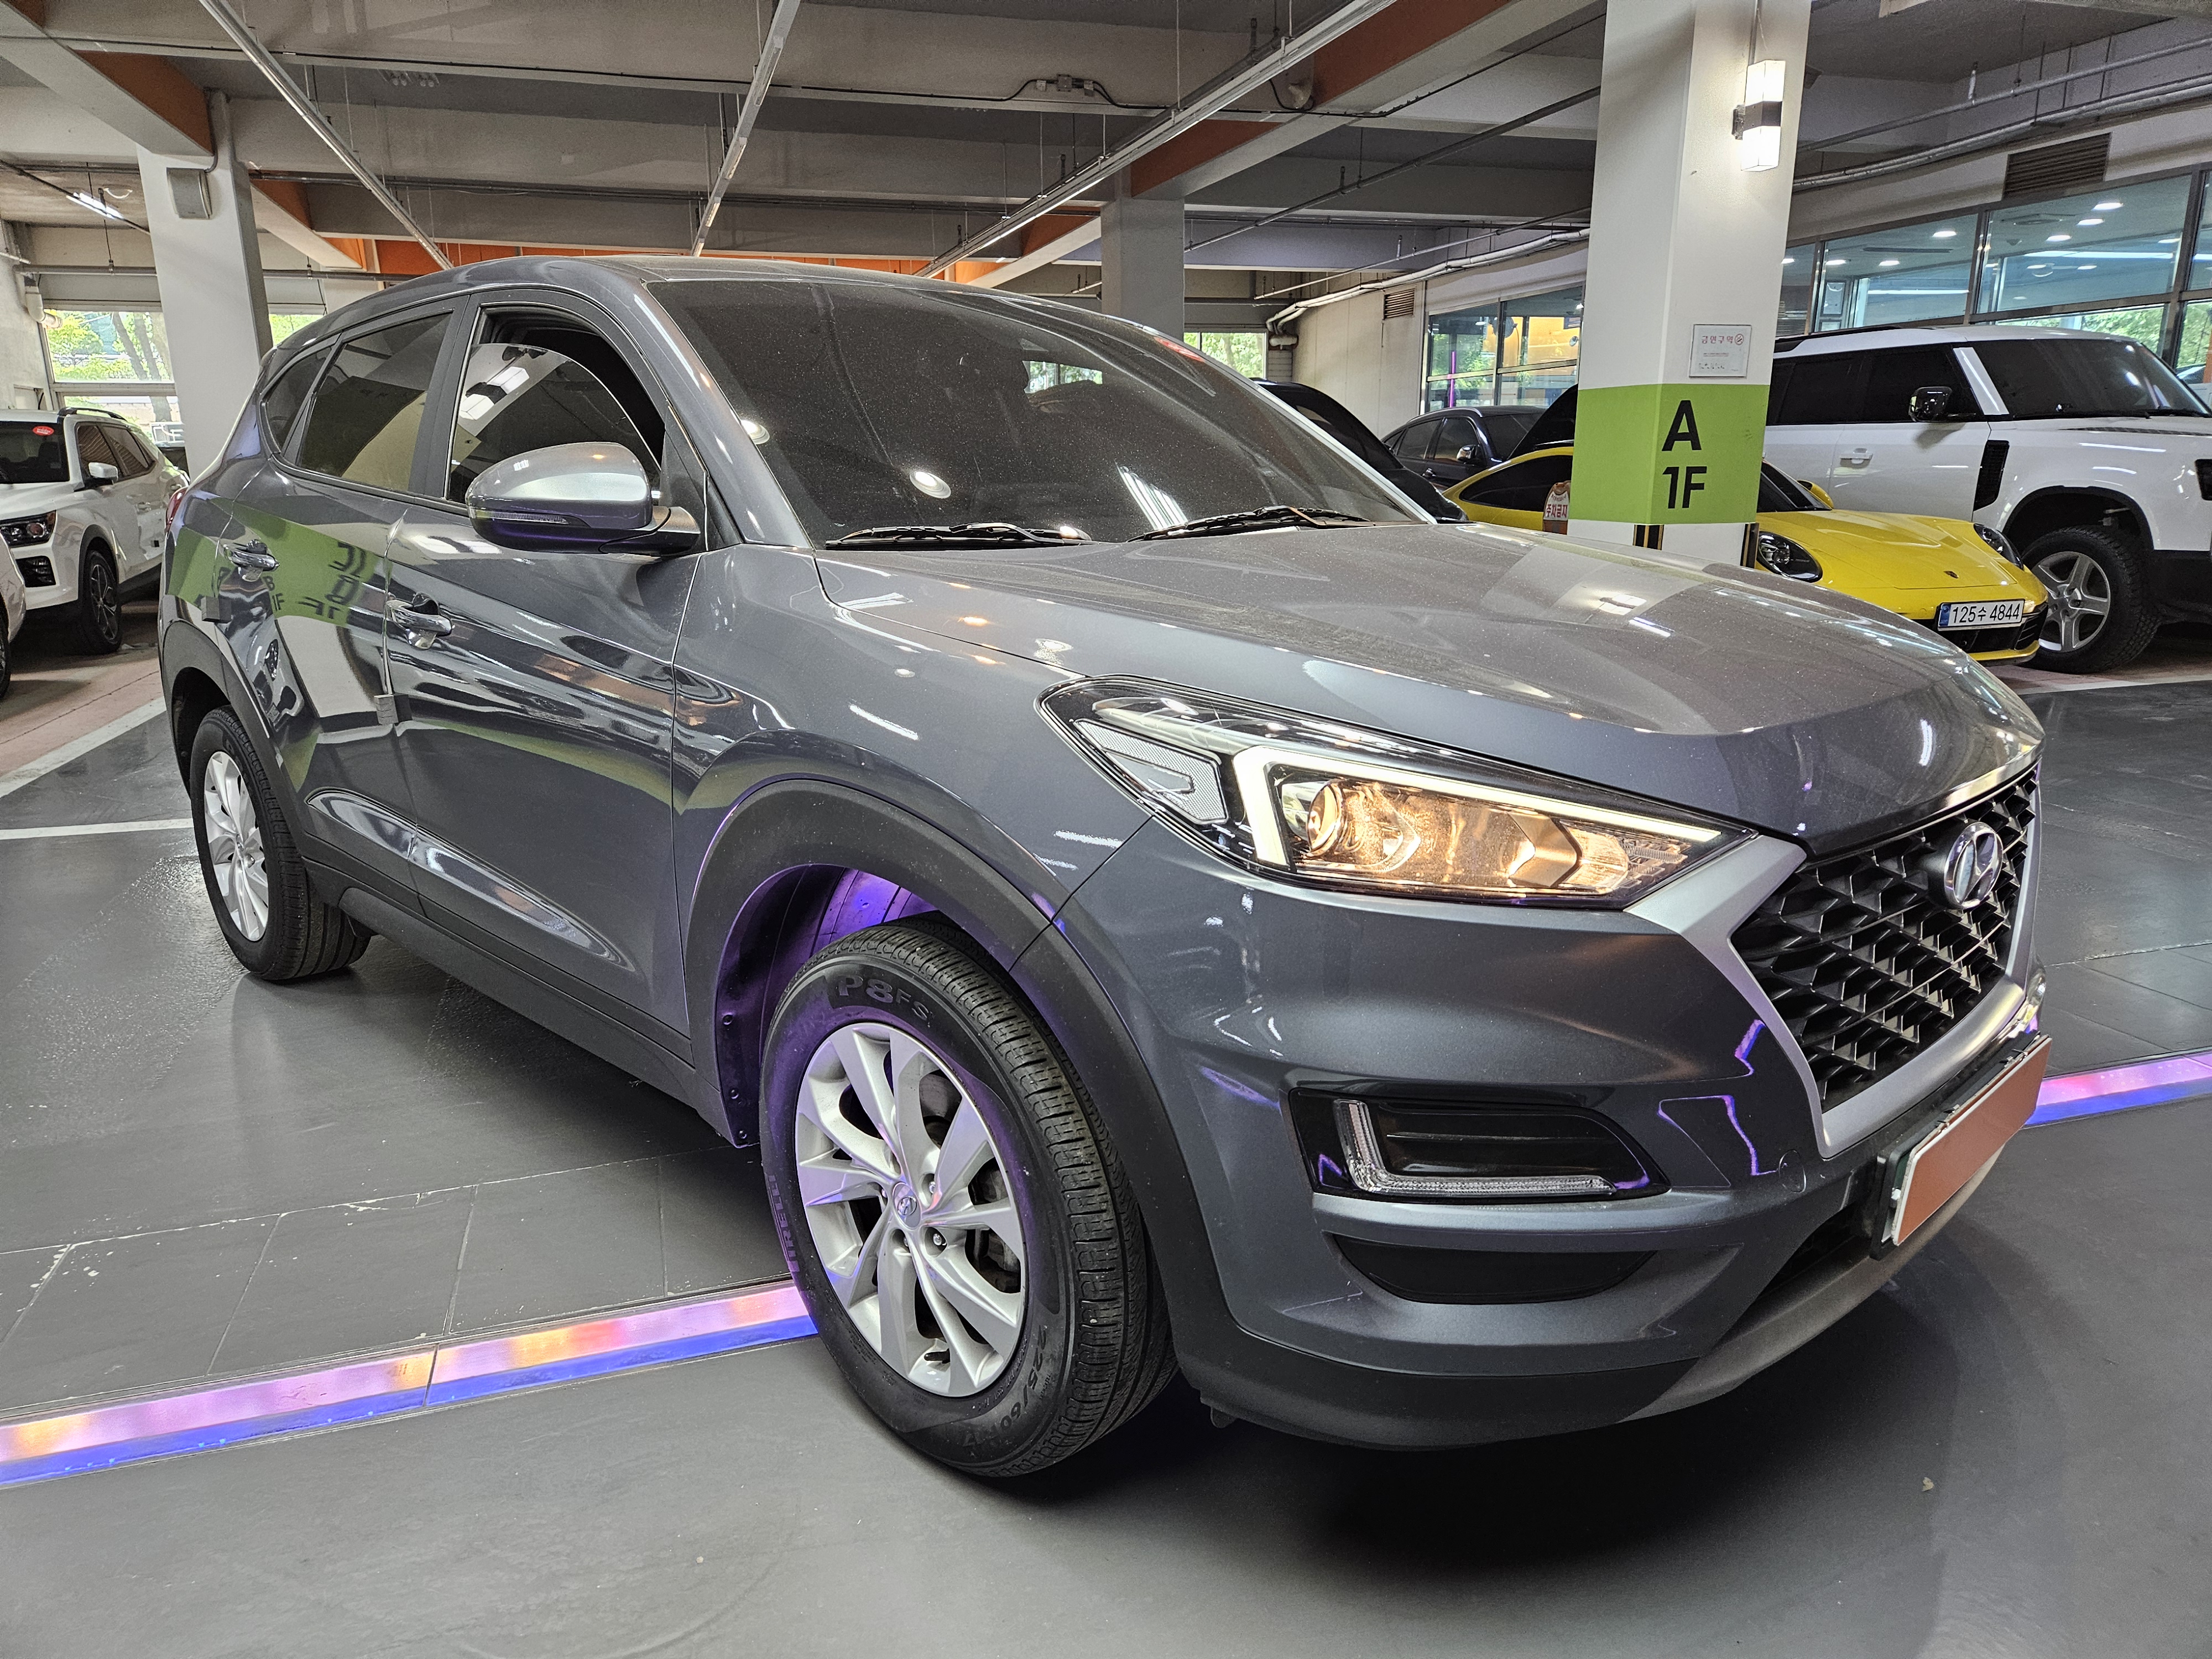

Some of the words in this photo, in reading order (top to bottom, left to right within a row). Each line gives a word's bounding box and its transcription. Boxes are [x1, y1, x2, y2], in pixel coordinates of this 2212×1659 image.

[1702, 335, 1733, 344] 금연구역
[1661, 399, 1702, 452] A
[1662, 466, 1708, 509] 1F
[1546, 504, 1568, 518] 주차금지
[1953, 606, 1987, 623] 125수
[1989, 603, 2020, 621] 4844
